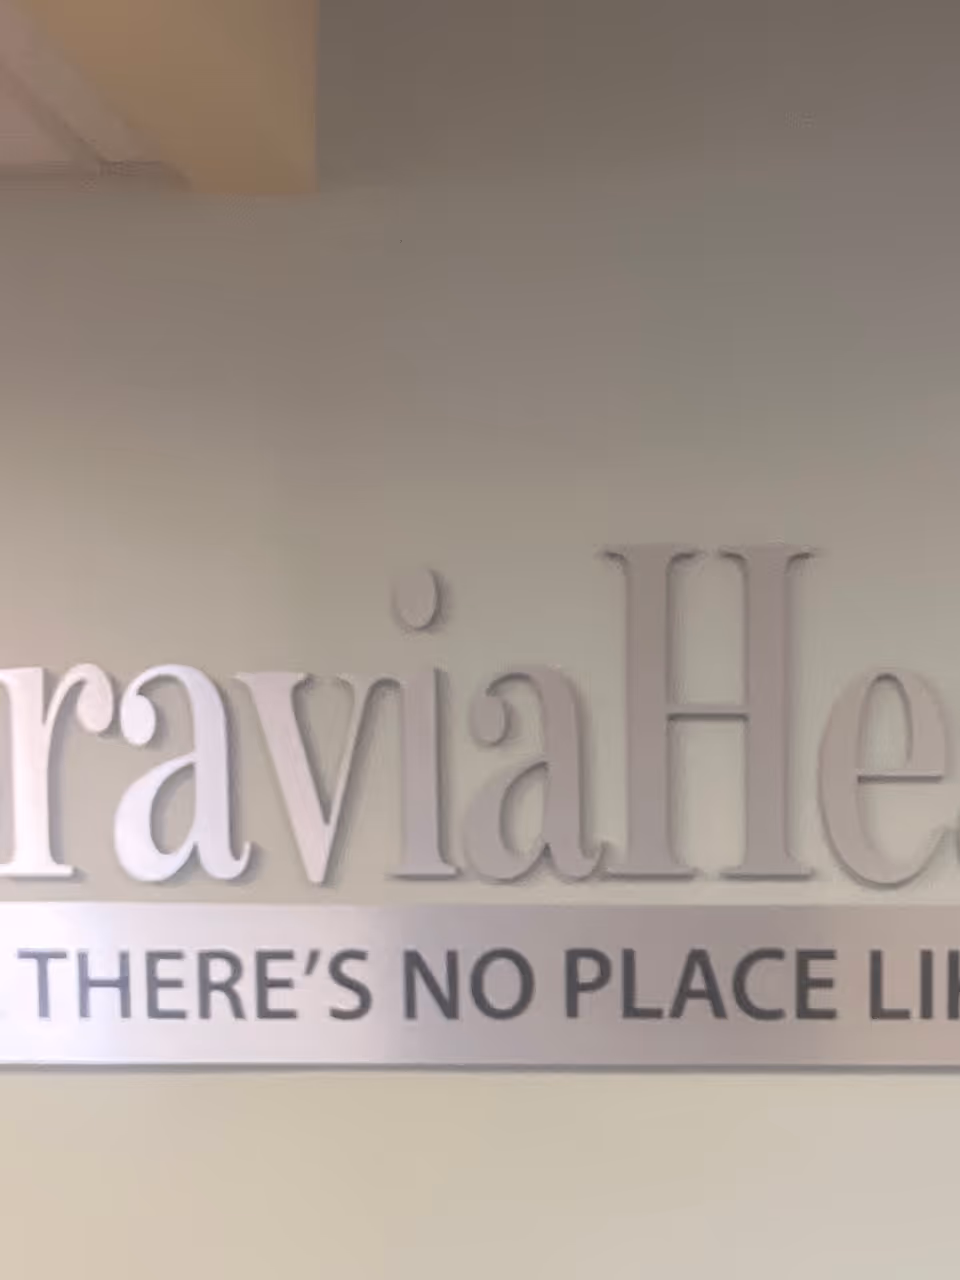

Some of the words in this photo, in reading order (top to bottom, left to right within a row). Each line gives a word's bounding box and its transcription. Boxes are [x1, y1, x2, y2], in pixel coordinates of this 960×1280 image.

[17, 948, 374, 1020] THERE’S
[404, 948, 537, 1020] NO
[565, 948, 837, 1020] PLACE
